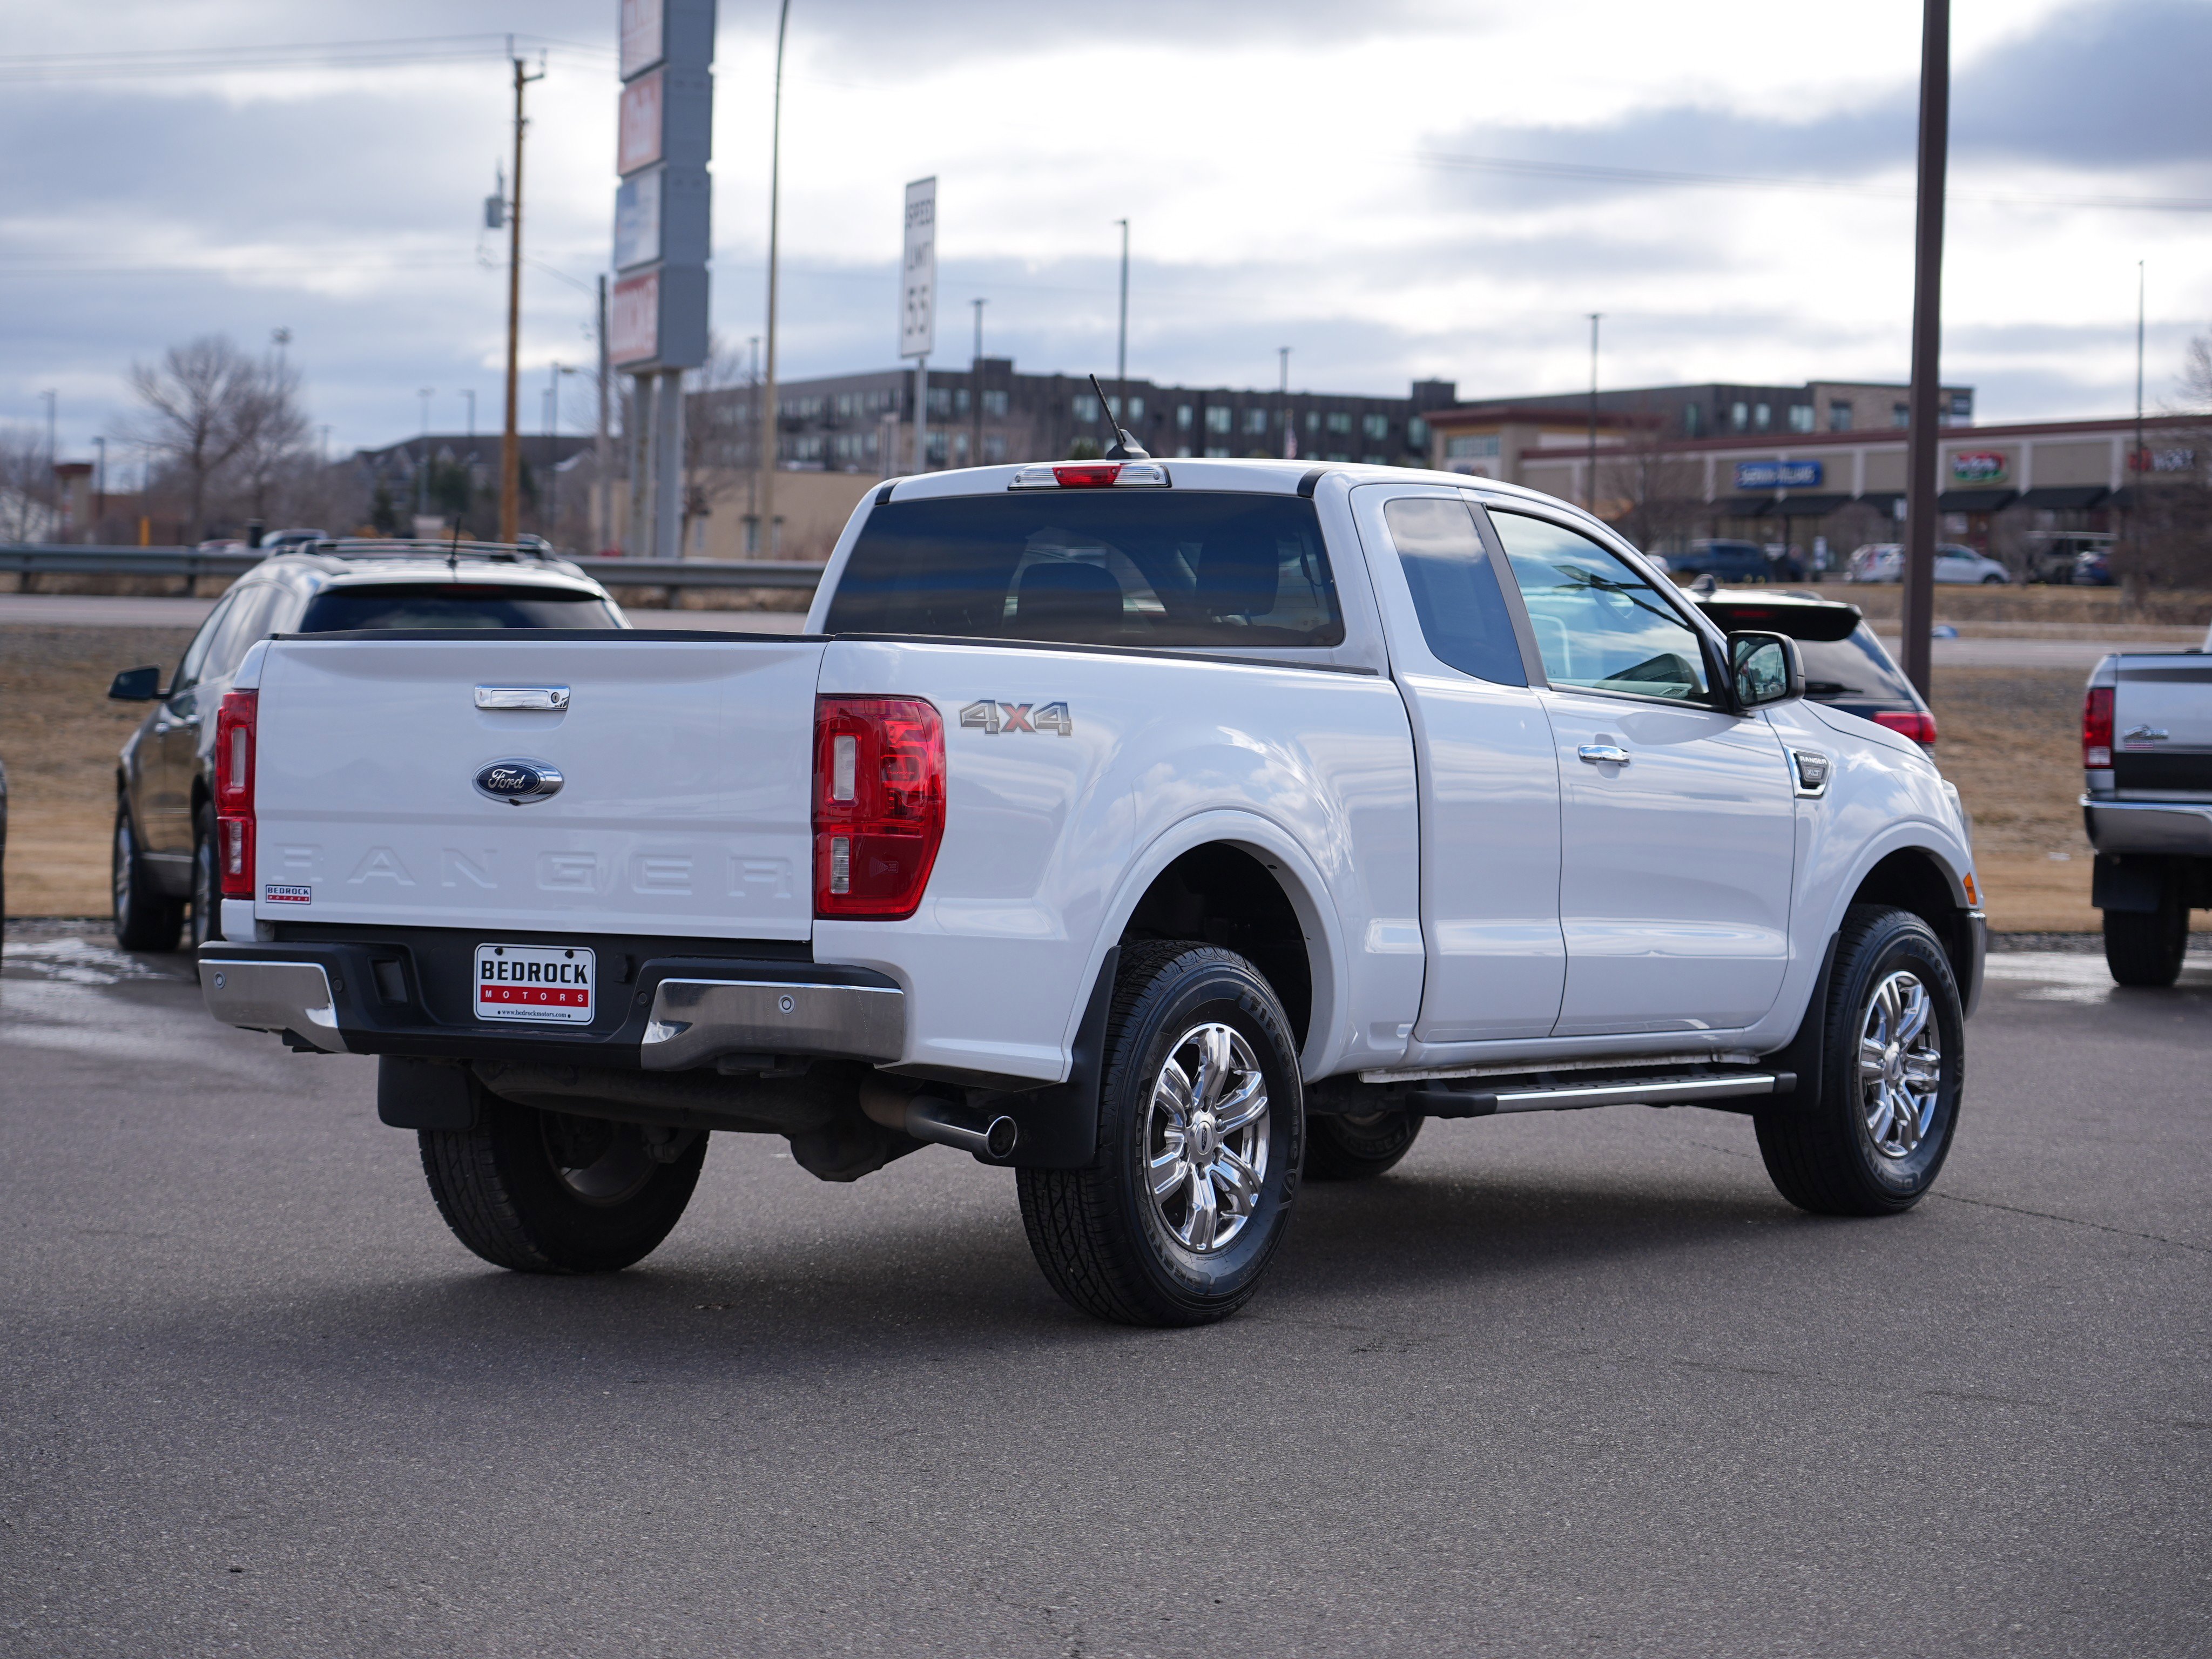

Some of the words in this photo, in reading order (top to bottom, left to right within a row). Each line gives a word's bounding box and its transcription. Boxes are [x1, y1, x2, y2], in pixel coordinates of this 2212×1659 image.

[905, 284, 929, 335] 55
[1800, 756, 1827, 765] RANGER
[488, 768, 525, 788] Ford
[1806, 768, 1820, 777] XLT
[271, 842, 792, 899] RANGER
[481, 960, 588, 984] BEDROCK
[485, 990, 583, 1002] MOTORS
[502, 1009, 567, 1018] www.bedrockmotors.com
